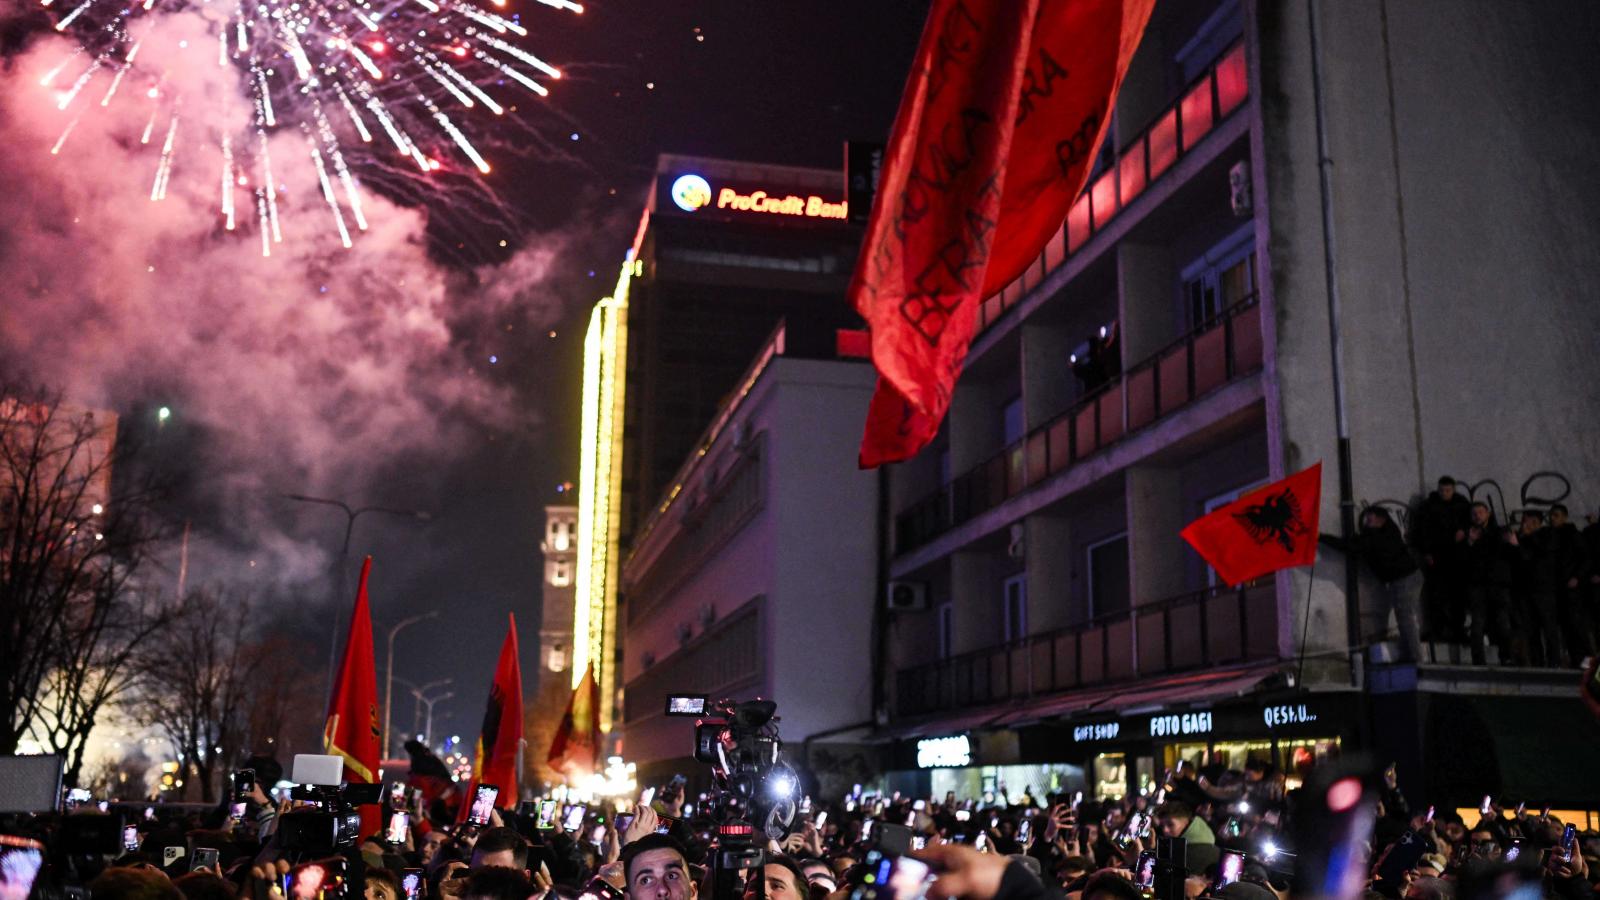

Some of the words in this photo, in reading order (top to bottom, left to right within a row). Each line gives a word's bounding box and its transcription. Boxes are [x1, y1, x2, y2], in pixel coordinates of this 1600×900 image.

[717, 187, 805, 216] ProCredit
[1074, 725, 1093, 742] GIFT
[1094, 722, 1119, 740] SHOP
[1151, 715, 1179, 736] FOTO
[1182, 712, 1212, 733] GAGI
